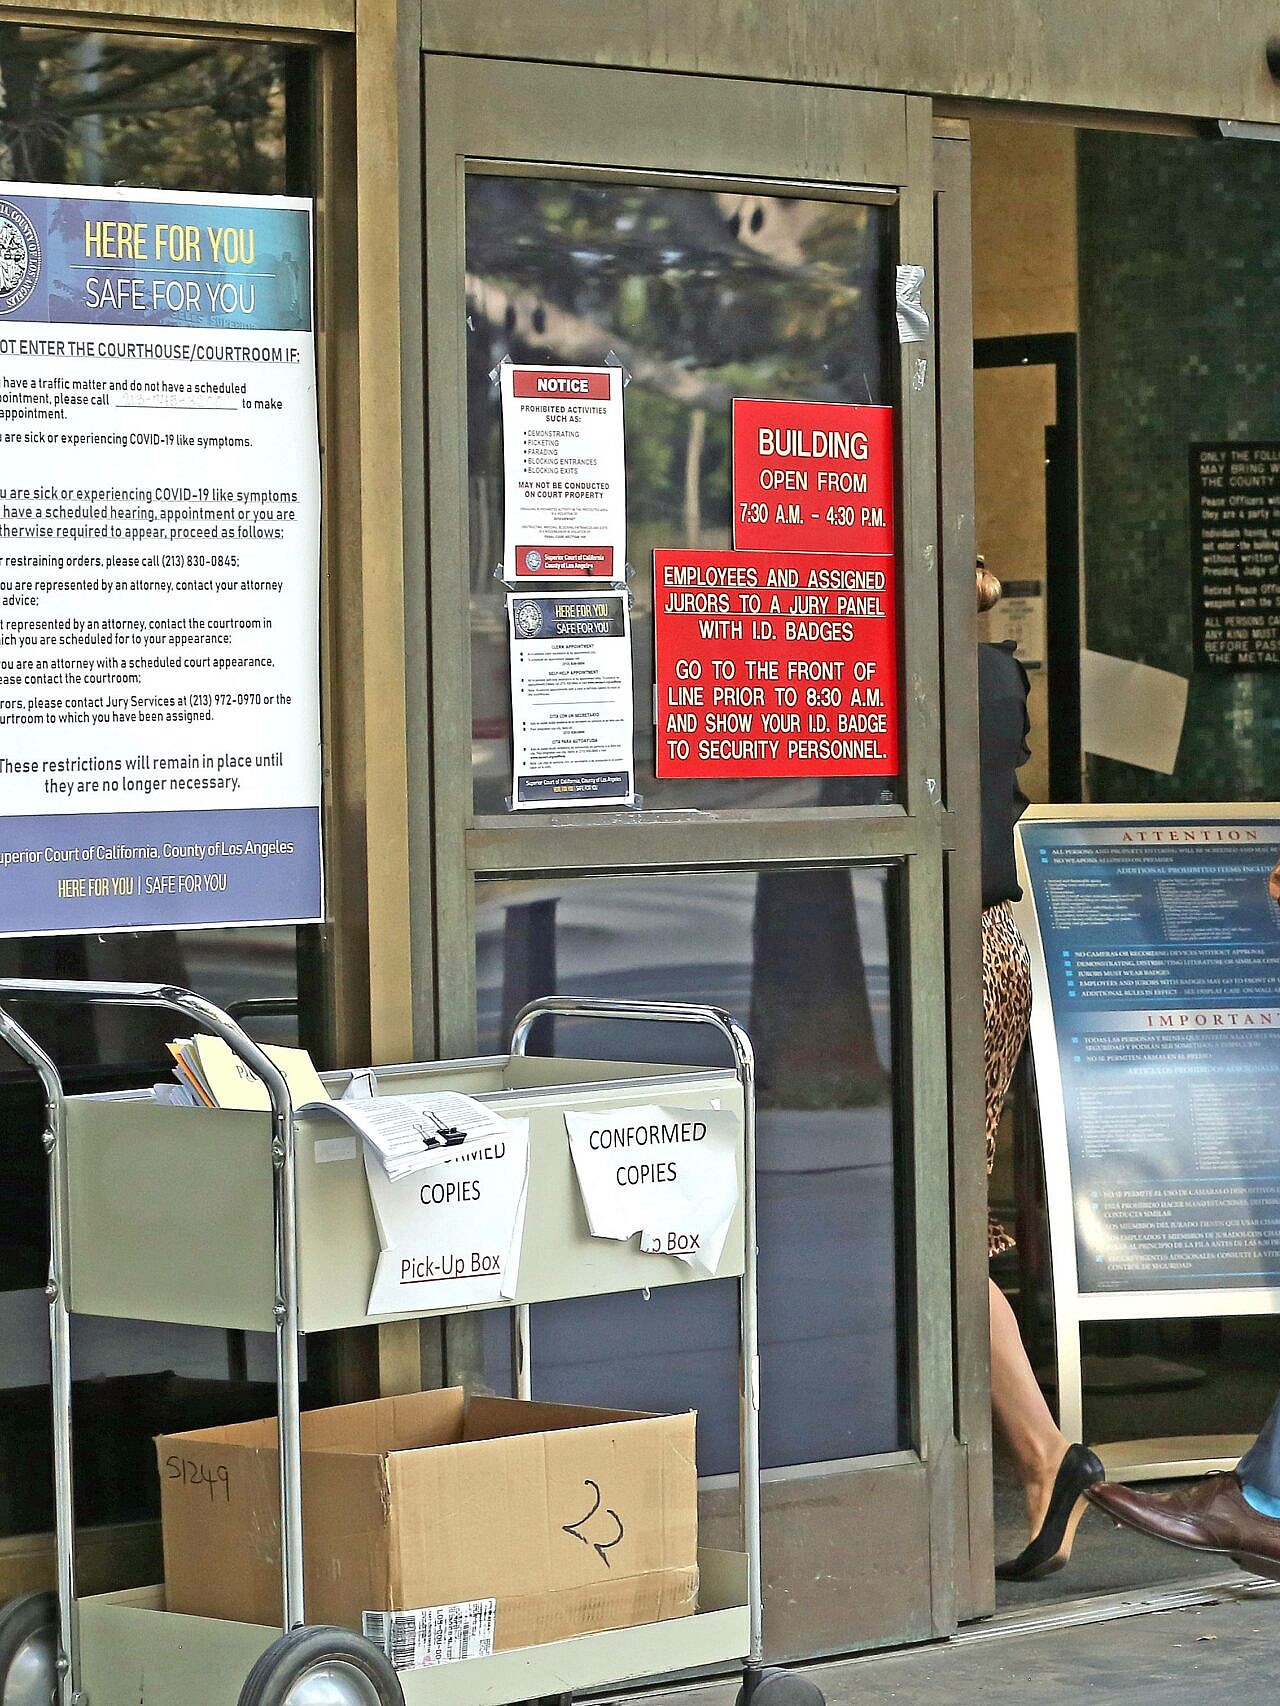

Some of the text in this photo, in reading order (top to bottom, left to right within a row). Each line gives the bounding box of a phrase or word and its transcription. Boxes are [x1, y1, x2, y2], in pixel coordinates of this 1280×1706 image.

[84, 221, 256, 265] HERE FOR YOU
[85, 276, 256, 315] SAFE FOR YOU
[0, 338, 301, 363] OT ENTER THE COURTHOUSE/COURTROOM IF:
[537, 378, 589, 393] NOTICE
[520, 404, 607, 415] PROHIBITED ACTIVITIES
[545, 415, 582, 423] SUCH AS:
[759, 428, 867, 459] BUILDING
[1200, 464, 1224, 474] MAY
[1230, 463, 1264, 474] BRING
[518, 481, 533, 489] MAY
[564, 482, 610, 490] CONDUCTED
[760, 469, 866, 492] OPEN FROM
[1201, 476, 1223, 487] THE
[1229, 475, 1274, 486] COUNTY
[524, 490, 536, 498] ON
[564, 491, 604, 499] PROPERTY
[740, 502, 768, 523] 7:30
[775, 504, 803, 523] A.M.
[826, 506, 854, 525] 4:30
[861, 507, 885, 526] P.M.
[4, 554, 240, 571] restraining orders, please call (213) 830-0845;
[664, 566, 885, 591] EMPLOYEES AND ASSIGNED
[555, 603, 609, 618] HERE FOR YOU
[664, 593, 885, 616] JURORS TO A JURY PANEL
[556, 622, 609, 634] SAFE FOR YOU
[698, 619, 853, 641] WITH I.D. BADGES
[676, 659, 876, 680] GO TO THE FRONT OF
[668, 686, 883, 706] LINE PRIOR TO 8:30 A.M.
[666, 712, 886, 732] AND SHOW YOUR I.D. BADGE
[666, 739, 886, 759] TO SECURITY PERSONNEL.
[0, 752, 282, 773] These restrictions will remain in place until
[44, 776, 240, 796] they are no longer necessary.
[1122, 830, 1257, 842] ATTENTION
[589, 1122, 706, 1149] CONFORMED
[616, 1161, 676, 1186] COPIES
[420, 1180, 480, 1204] COPIES
[667, 1232, 700, 1250] Box
[401, 1253, 500, 1279] Pick-Up Box
